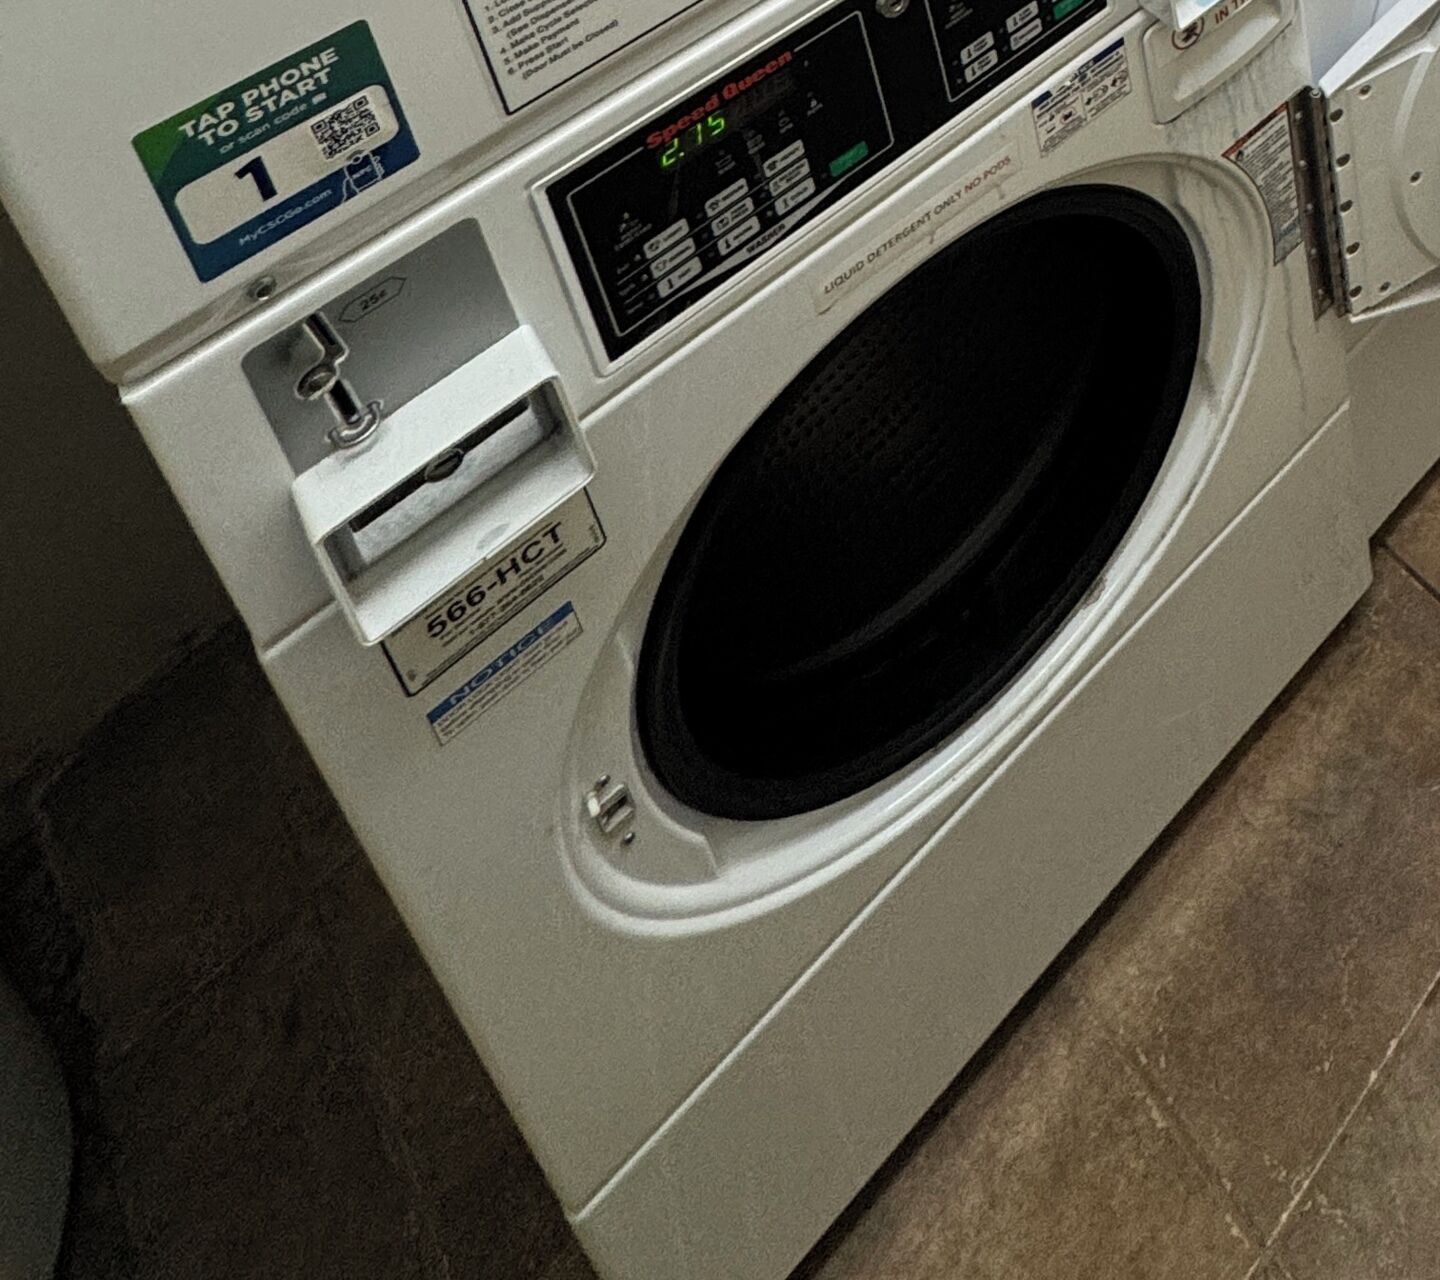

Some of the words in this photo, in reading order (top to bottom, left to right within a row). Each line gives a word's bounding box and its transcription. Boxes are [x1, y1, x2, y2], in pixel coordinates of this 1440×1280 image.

[1214, 5, 1230, 25] IN
[178, 101, 235, 138] TAP
[241, 47, 339, 108] PHONE
[198, 119, 239, 147] TO
[245, 67, 332, 123] START
[646, 94, 721, 150] Speed
[722, 50, 794, 100] Queen
[220, 141, 235, 154] or
[234, 155, 278, 203] 1
[823, 260, 864, 295] LIQUID
[865, 212, 932, 265] DETERGENT
[932, 189, 963, 218] ONLY
[963, 176, 982, 194] NO
[427, 521, 562, 639] 566-HCT
